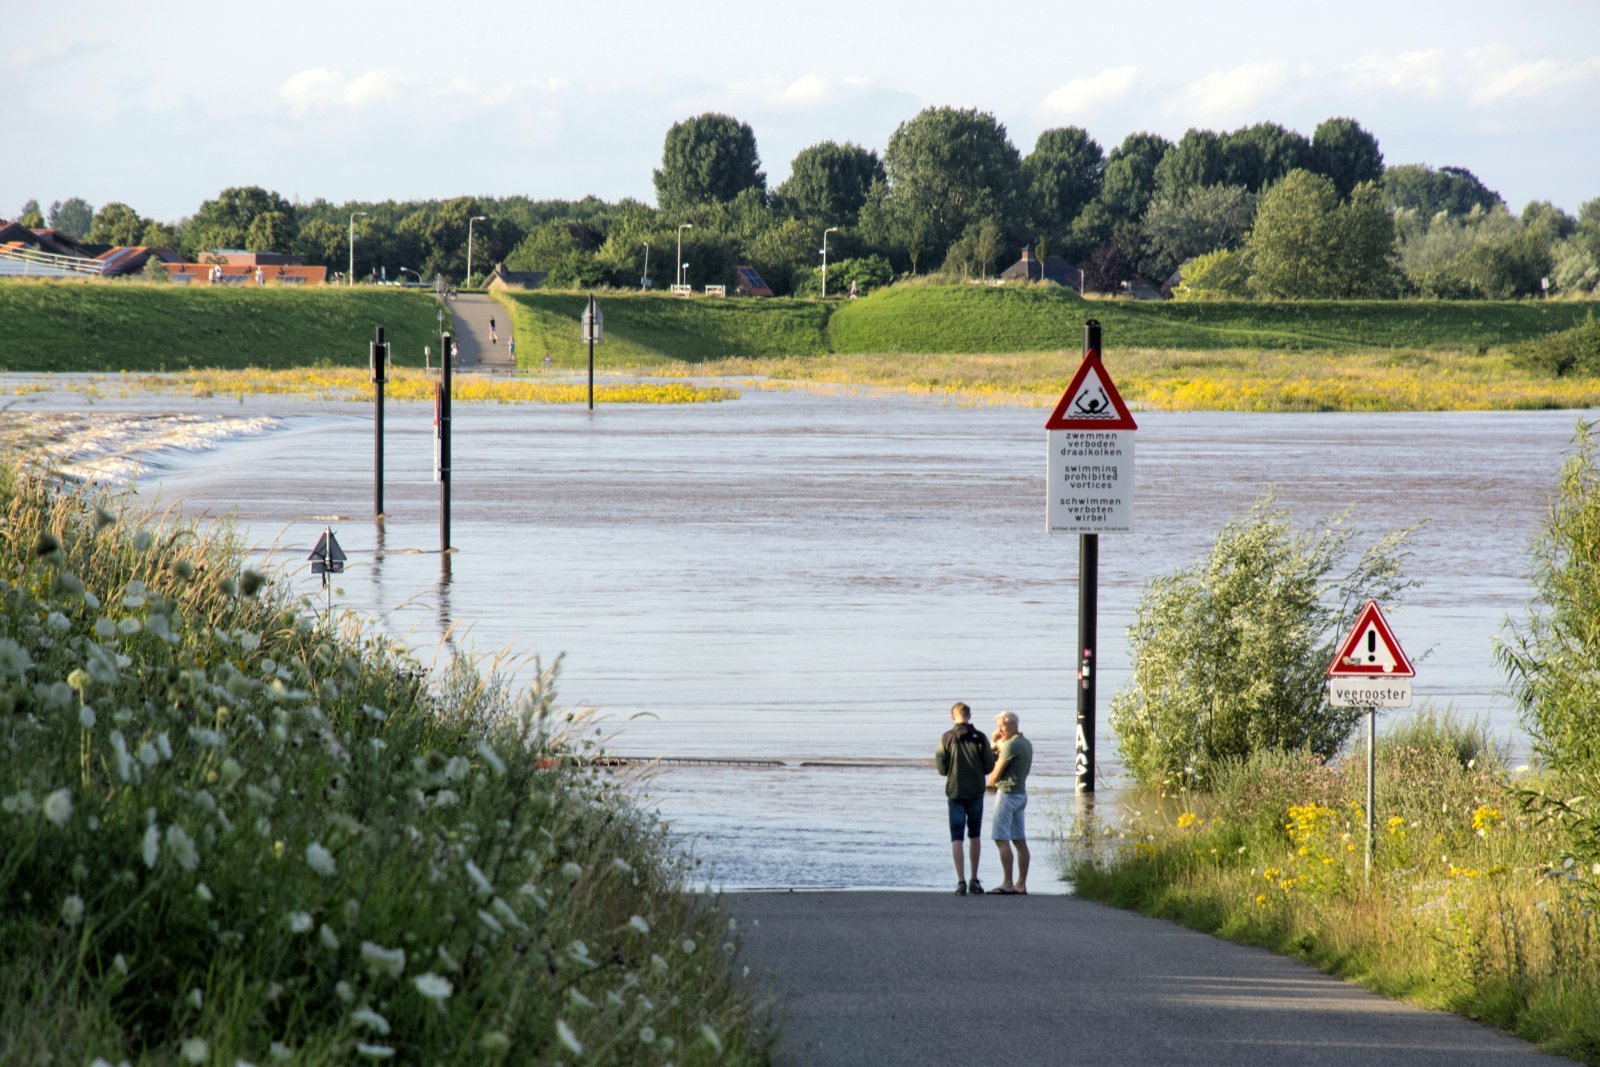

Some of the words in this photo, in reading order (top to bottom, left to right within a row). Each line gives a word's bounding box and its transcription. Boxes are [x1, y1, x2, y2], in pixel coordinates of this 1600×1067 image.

[1060, 448, 1121, 456] draaikolken
[1065, 465, 1117, 474] swimming
[1065, 473, 1117, 481] prohibited
[1060, 497, 1120, 505] schwimmen
[1337, 688, 1406, 700] veerooster
